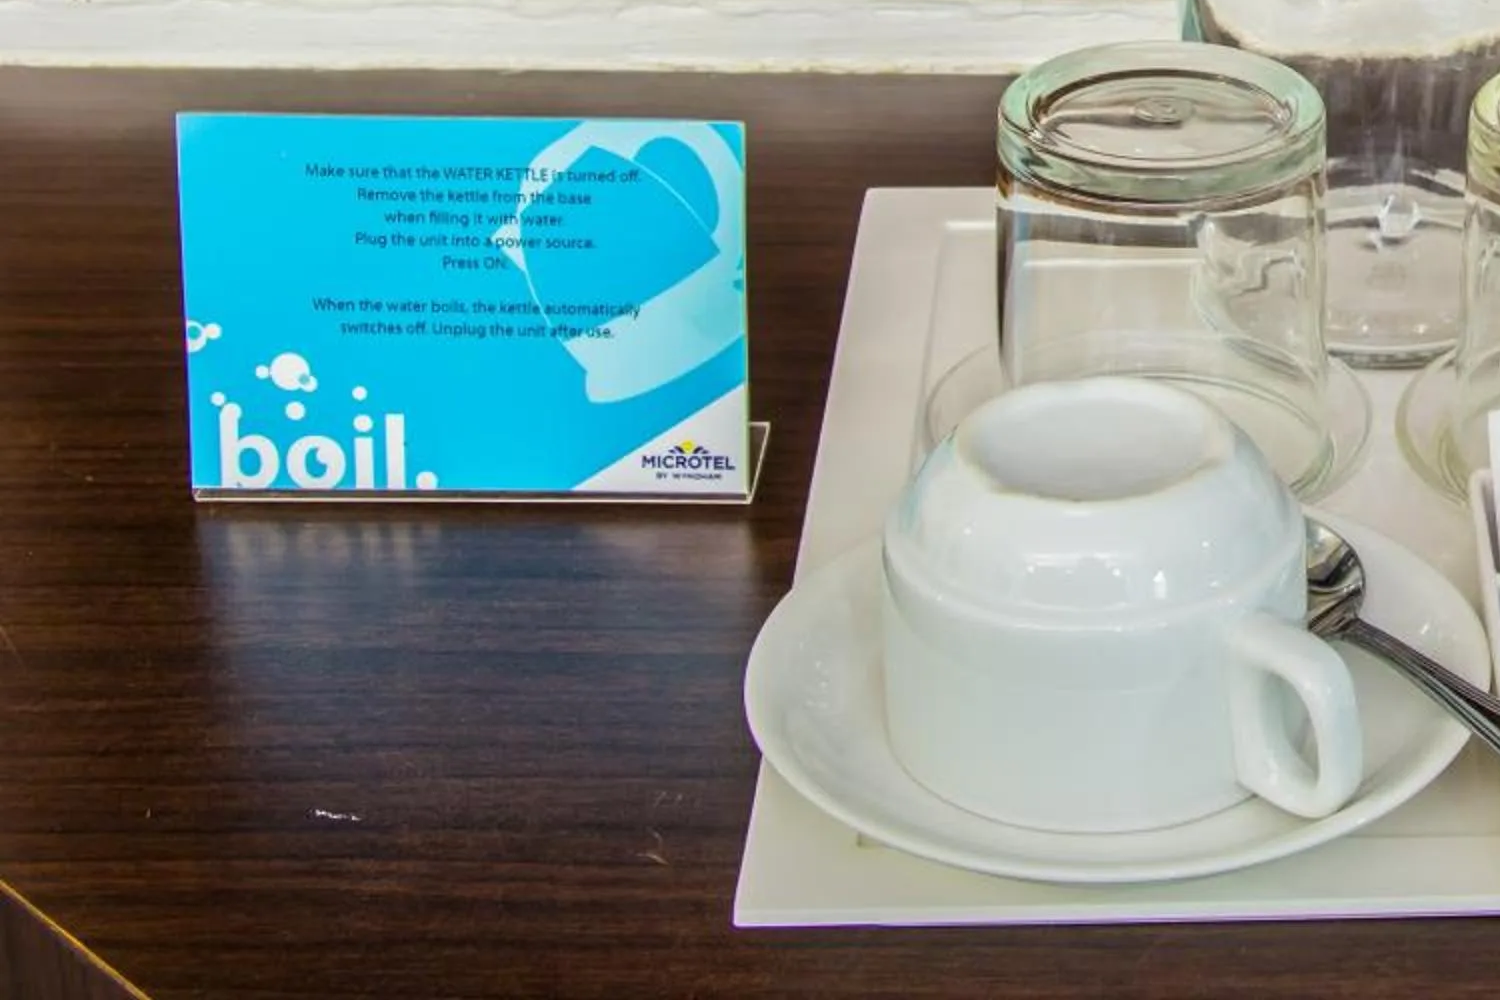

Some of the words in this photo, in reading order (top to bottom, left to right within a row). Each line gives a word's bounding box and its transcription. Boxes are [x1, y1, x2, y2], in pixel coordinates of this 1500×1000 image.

[305, 164, 344, 177] Make
[347, 166, 379, 178] sure
[383, 164, 413, 179] that
[415, 165, 440, 179] the
[442, 167, 493, 180] WATER
[496, 167, 548, 182] KETTLE
[551, 168, 563, 181] is
[567, 168, 615, 182] turned
[619, 169, 641, 182] off.
[357, 187, 416, 200] Remove
[419, 188, 443, 201] the
[447, 188, 489, 202] kettle
[491, 189, 526, 203] from
[529, 191, 554, 205] the
[557, 191, 592, 205] base
[385, 211, 425, 224] when
[429, 211, 469, 226] filling
[473, 212, 483, 224] it
[487, 213, 518, 225] with
[355, 232, 387, 248] Plug
[391, 232, 415, 245] the
[419, 233, 448, 247] unit
[451, 234, 480, 247] into
[485, 238, 493, 247] a
[495, 238, 542, 251] power
[545, 239, 597, 250] source.
[442, 255, 480, 269] Press
[312, 298, 355, 312] When
[358, 298, 383, 312] the
[386, 301, 426, 313] water
[472, 300, 496, 314] the
[500, 301, 541, 314] kettle
[545, 302, 640, 320] automatically
[340, 322, 403, 335] switches
[432, 322, 487, 338] Unplug
[489, 323, 514, 337] the
[517, 324, 546, 338] unit
[551, 324, 583, 339] after
[587, 327, 615, 339] use.
[219, 403, 439, 489] boil.
[641, 455, 736, 471] MICROTEL
[656, 472, 667, 480] BY
